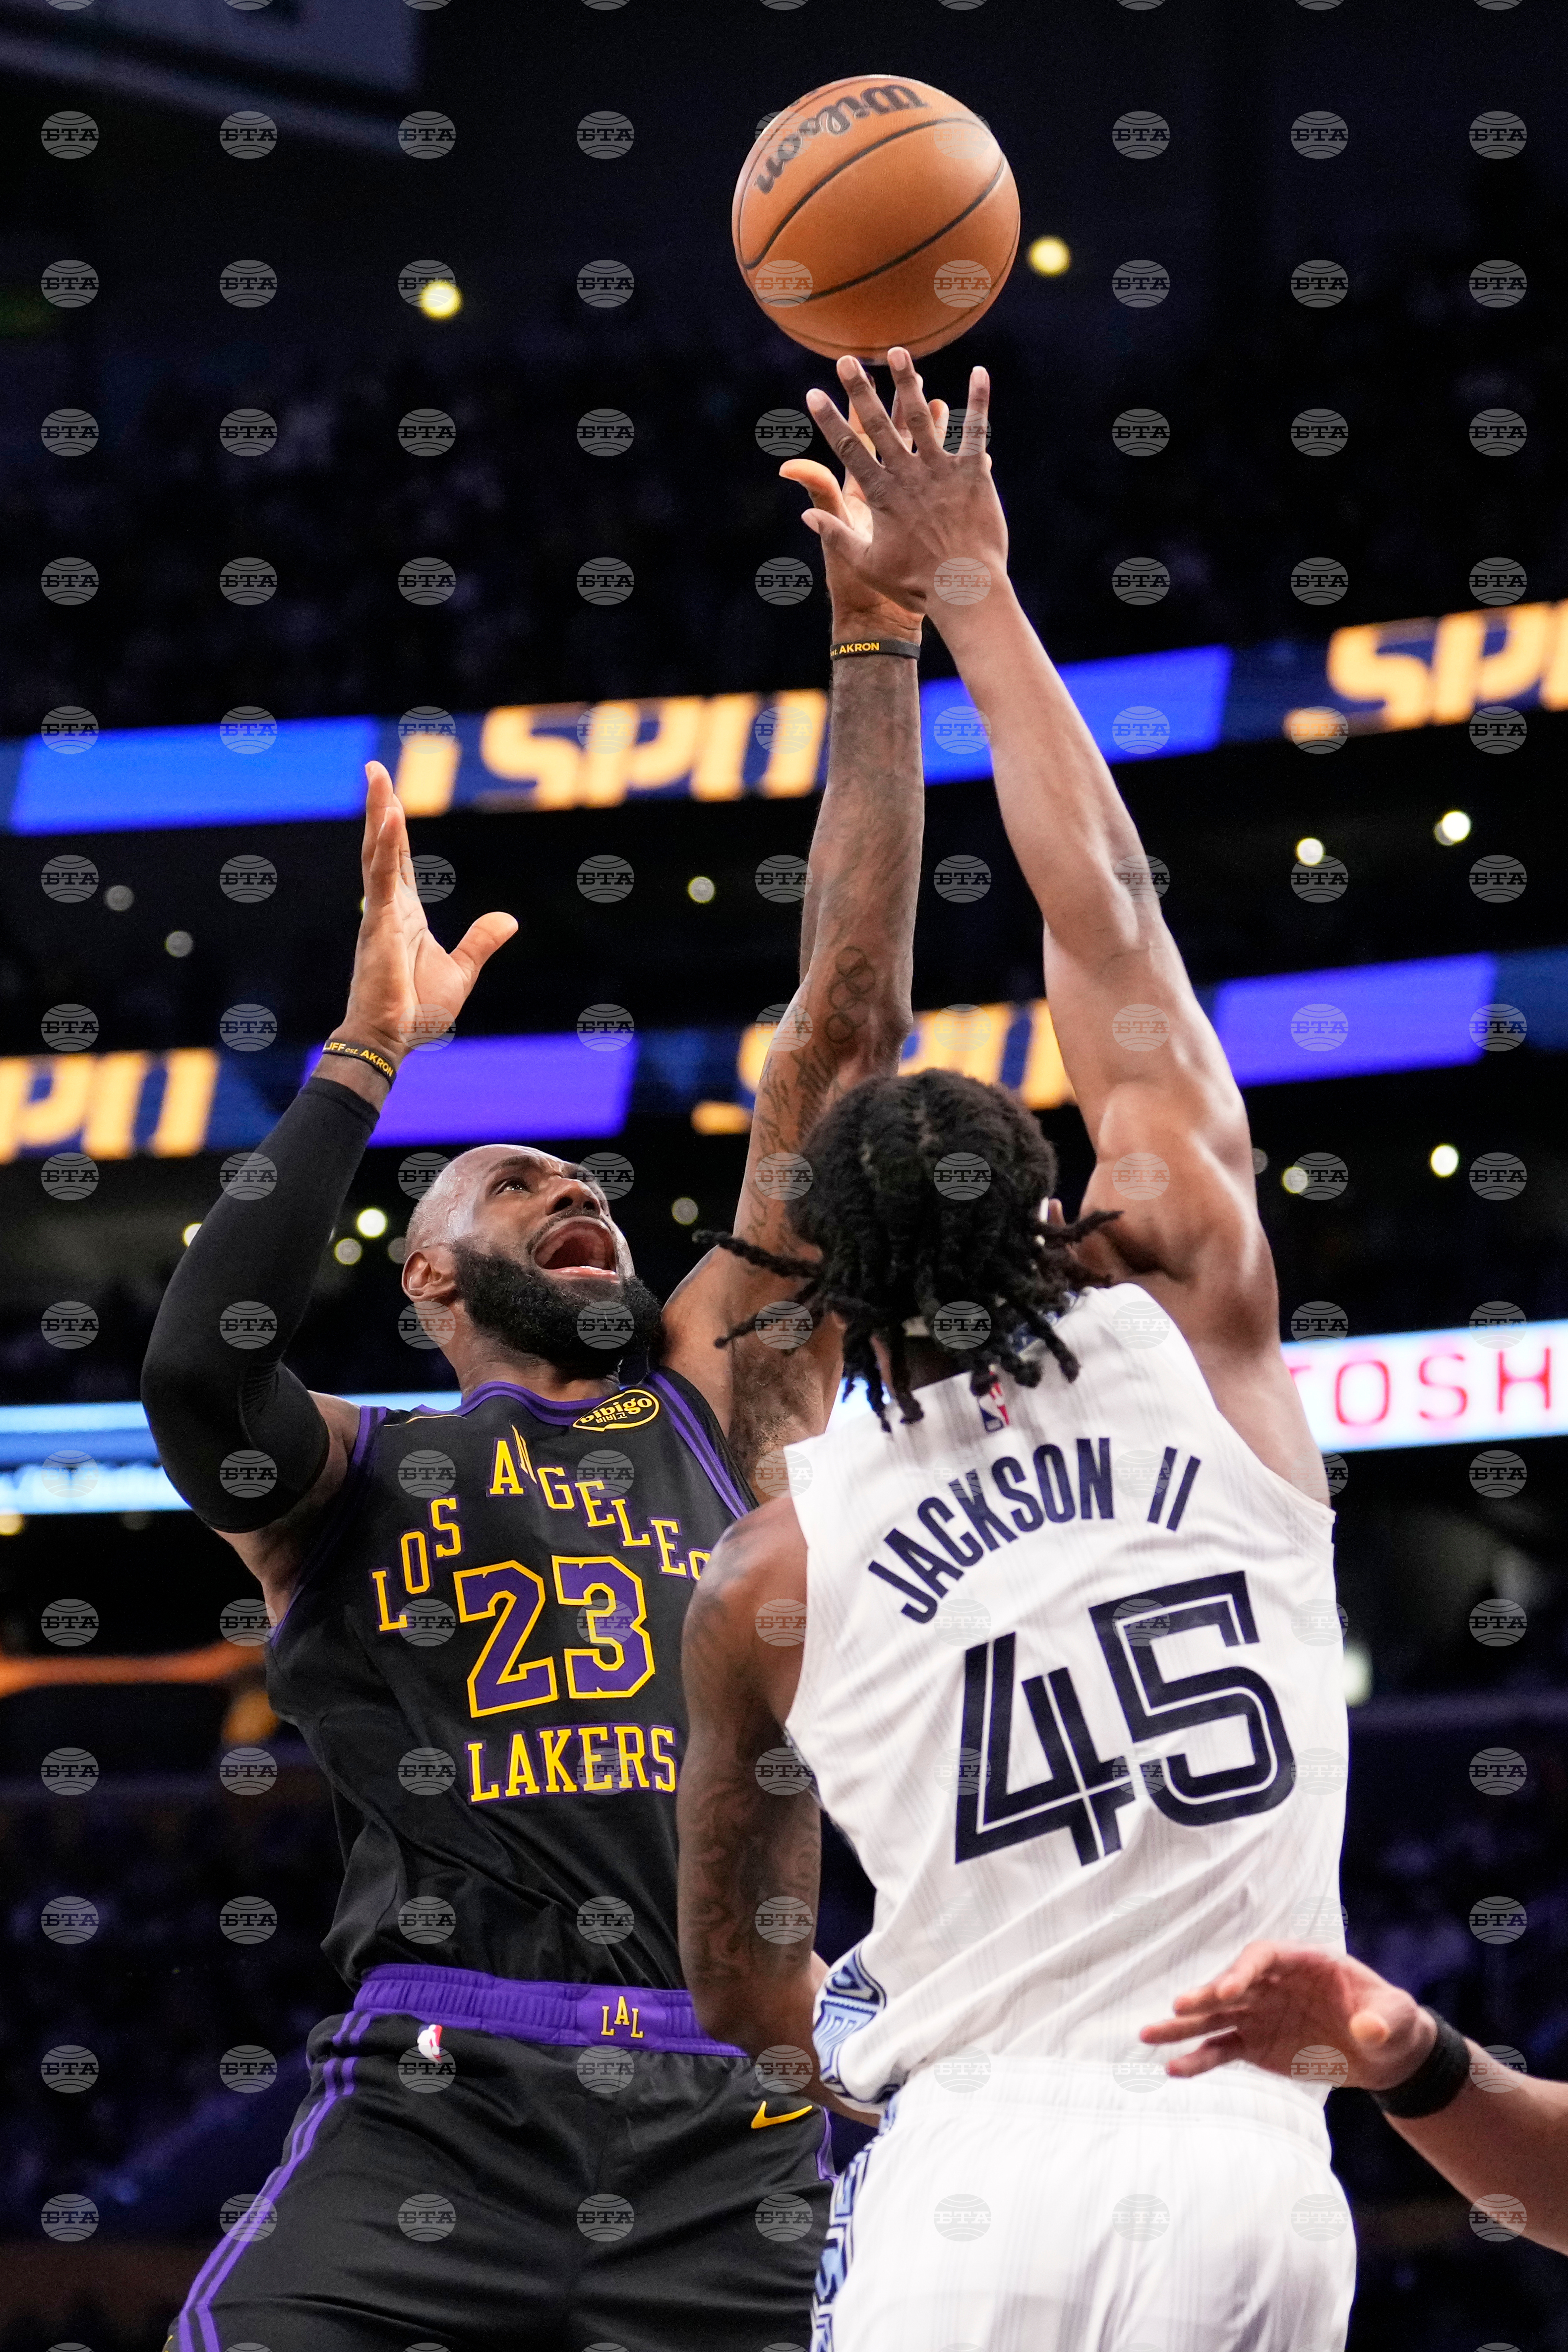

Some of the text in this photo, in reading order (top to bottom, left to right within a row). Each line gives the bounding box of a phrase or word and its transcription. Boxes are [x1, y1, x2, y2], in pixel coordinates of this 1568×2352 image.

[754, 84, 931, 194] Wilson
[839, 642, 879, 654] AKRON
[360, 1050, 394, 1077] AKRON
[580, 1398, 653, 1424] bibigo
[595, 1412, 628, 1424] 비비고
[1289, 1345, 1551, 1427] OSH
[371, 1497, 463, 1632] LOS
[868, 1437, 1115, 1624] JACKSON
[453, 1555, 656, 1718] 23
[955, 1570, 1296, 1867] 45
[468, 1725, 676, 1802] LAKERS
[601, 1996, 643, 2038] LAL
